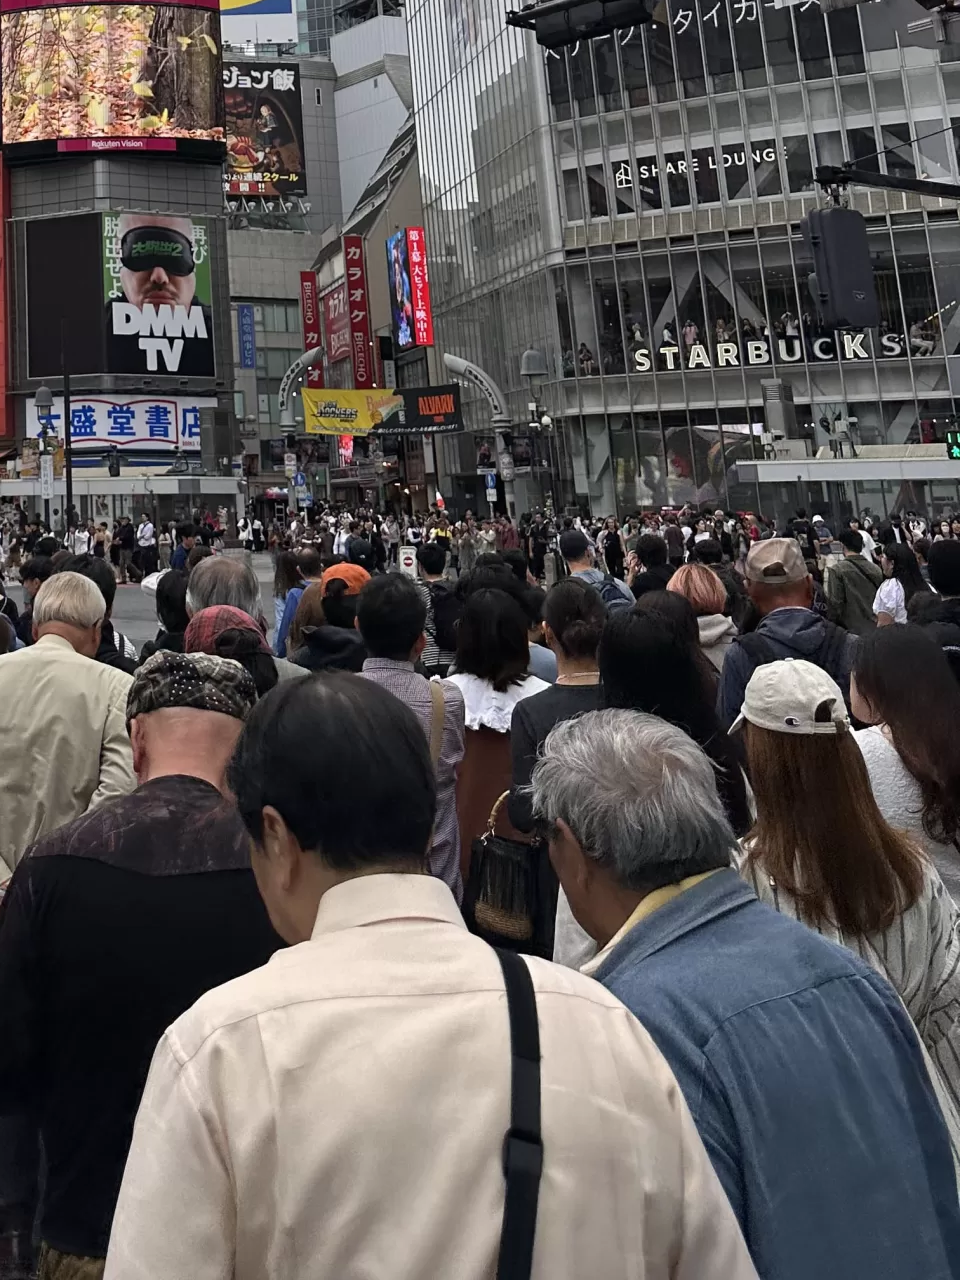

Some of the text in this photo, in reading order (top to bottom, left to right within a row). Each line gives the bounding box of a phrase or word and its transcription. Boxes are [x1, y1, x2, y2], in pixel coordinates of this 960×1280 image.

[91, 139, 143, 149] Rakuten Vision
[640, 158, 700, 179] SHARE
[104, 216, 123, 299] 脱出せよ
[191, 225, 208, 265] 再び
[347, 246, 366, 323] カラオケ
[112, 301, 208, 338] DMM
[138, 337, 184, 372] TV
[634, 331, 906, 371] STARBUCKS
